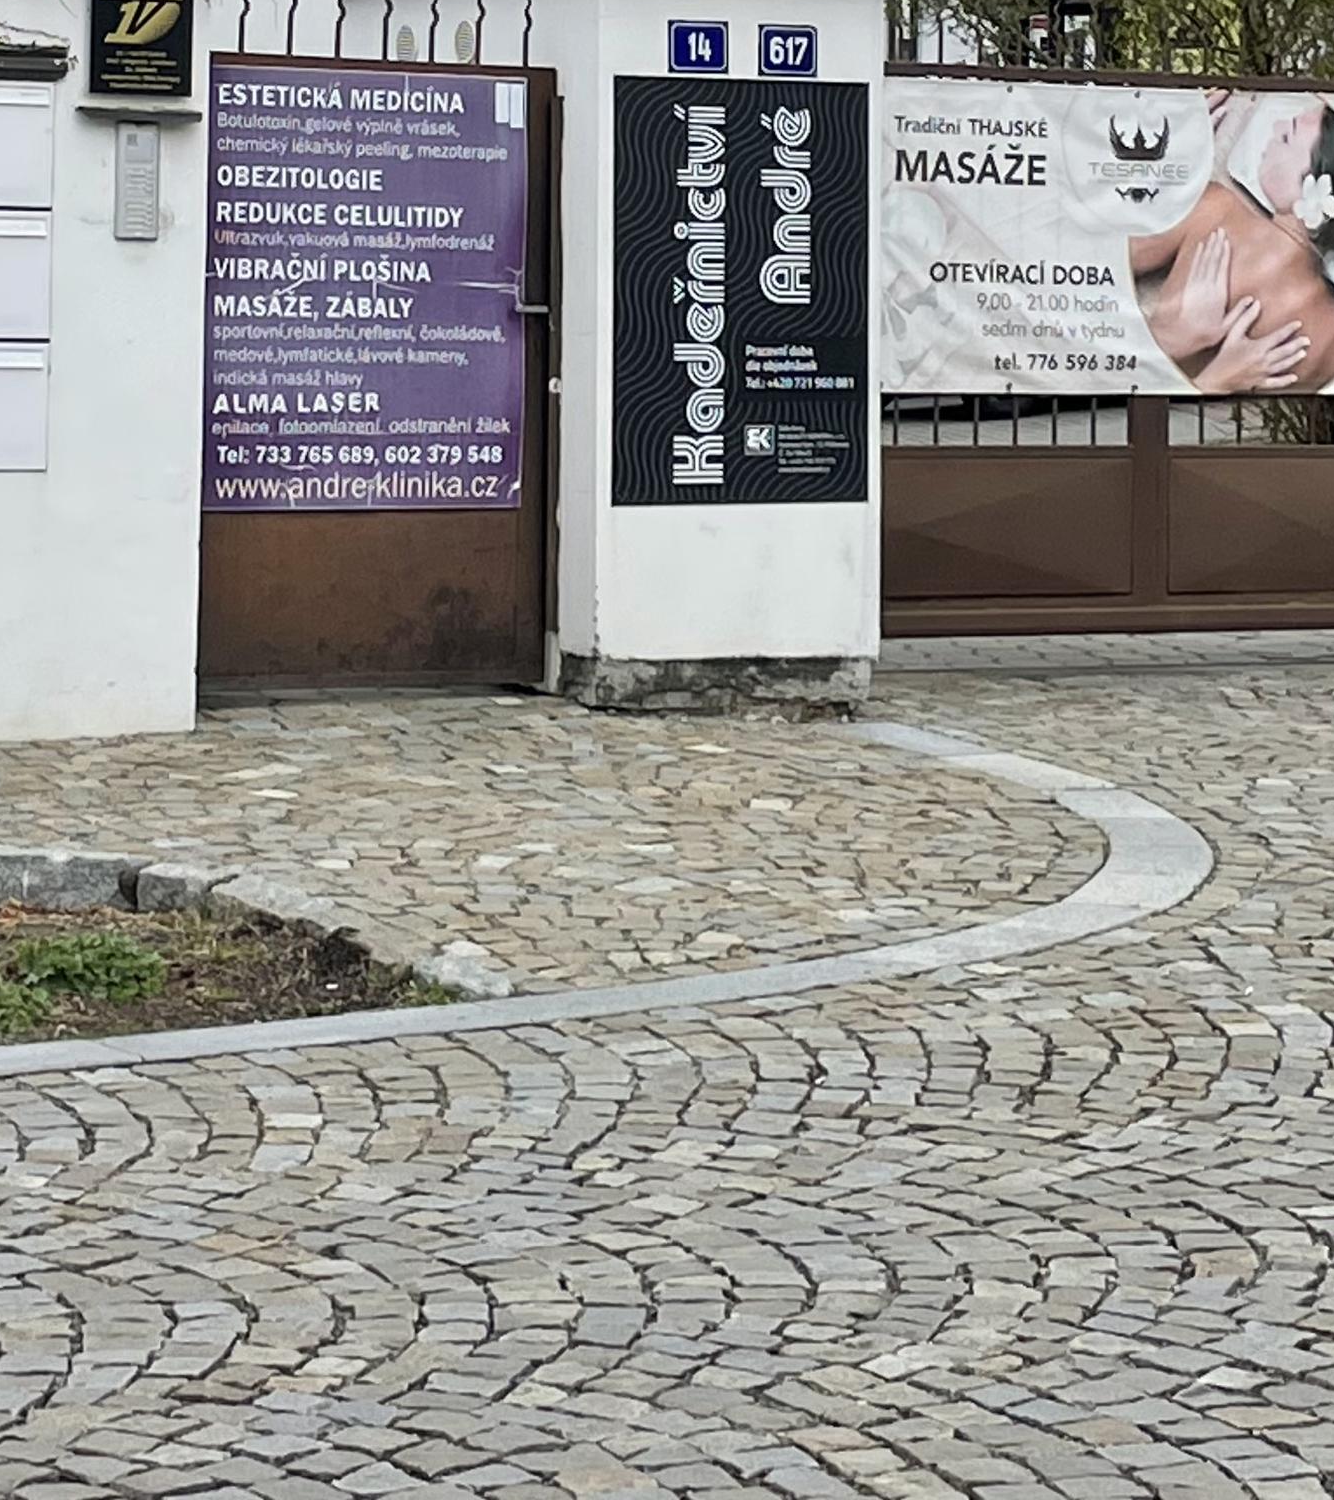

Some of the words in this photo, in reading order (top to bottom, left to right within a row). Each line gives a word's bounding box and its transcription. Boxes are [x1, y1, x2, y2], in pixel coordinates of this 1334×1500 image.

[687, 33, 711, 61] 14
[769, 36, 808, 66] 617
[218, 81, 343, 110] ESTETICKÁ
[356, 117, 403, 136] výplně
[894, 115, 962, 135] Tradiční
[967, 117, 1049, 139] THAJSKÉ
[217, 136, 288, 156] chemický
[291, 137, 353, 158] lékařský
[355, 141, 413, 160] peeling,
[417, 144, 508, 163] mezoterapie
[217, 164, 384, 192] OBEZITOLOGIE
[894, 143, 1048, 187] MASÁŽE
[216, 202, 327, 226] REDUKCE
[334, 205, 465, 229] CELULITIDY
[759, 106, 812, 304] André
[214, 252, 327, 281] VIBRAČNÍ
[333, 254, 432, 283] PLOŠINA
[929, 258, 1046, 286] OTEVÍRACÍ
[1053, 265, 1116, 286] DOBA
[214, 290, 319, 321] MASÁŽE,
[326, 290, 414, 318] ZÁBALY
[672, 103, 727, 486] Kadeřnictví
[1074, 294, 1120, 313] hodin
[981, 319, 1027, 338] sedm
[1068, 325, 1077, 338] v
[994, 352, 1022, 371] tel.
[1027, 353, 1058, 371] 776
[1066, 354, 1098, 371] 596
[1104, 354, 1138, 371] 384
[213, 369, 267, 386] indická
[271, 369, 322, 386] masáž
[325, 370, 364, 390] hlavy
[212, 392, 288, 414] ALMA
[297, 392, 380, 414] LASER
[388, 417, 471, 434] odstranění
[475, 416, 511, 434] žilek
[255, 445, 292, 464] 733
[298, 445, 333, 464] 765
[339, 445, 380, 467] 689,
[385, 445, 422, 464] 602
[427, 445, 462, 465] 379
[467, 445, 503, 464] 548
[216, 471, 499, 500] www.andre-klinika.cz
